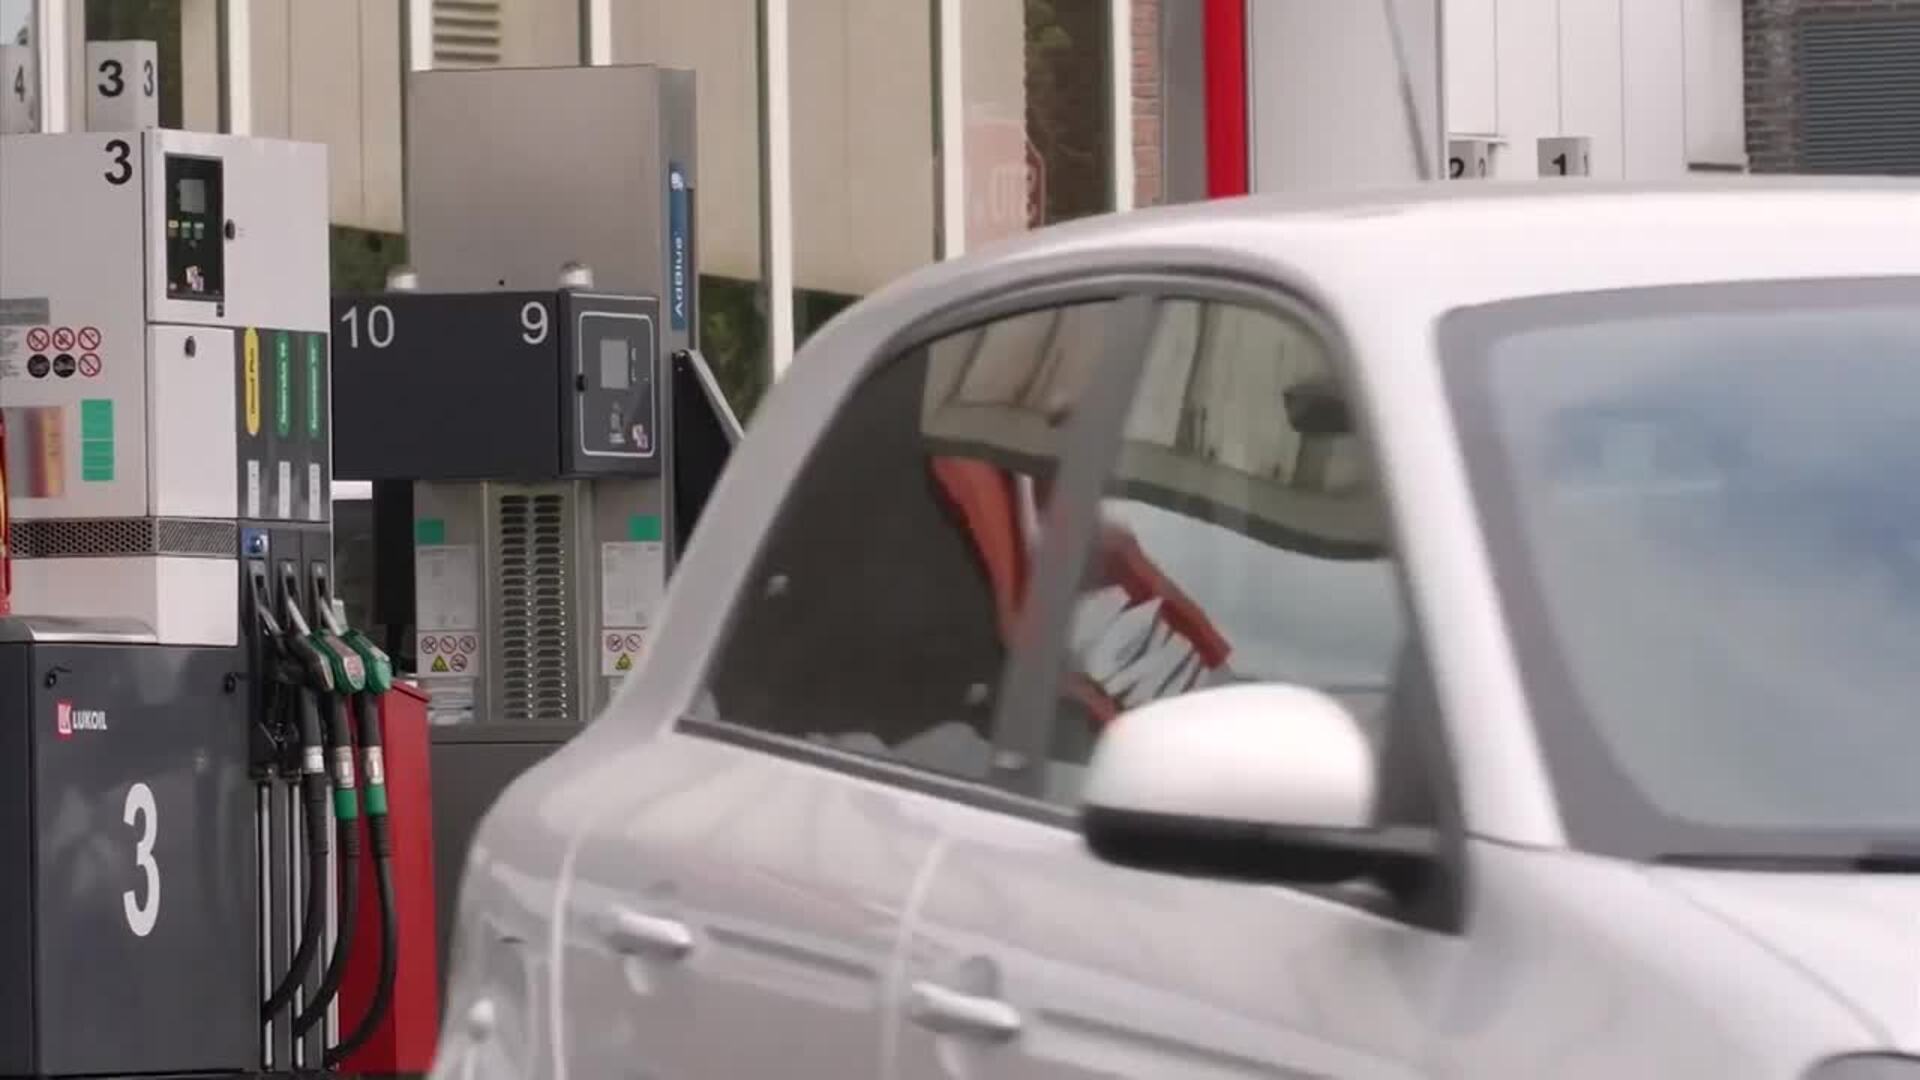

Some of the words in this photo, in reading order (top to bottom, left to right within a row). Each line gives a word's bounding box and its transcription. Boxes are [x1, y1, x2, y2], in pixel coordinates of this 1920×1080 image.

[14, 65, 25, 103] 4
[97, 59, 125, 98] 3
[143, 59, 154, 97] 3
[104, 139, 133, 185] 3
[1552, 153, 1567, 176] 1
[674, 236, 684, 318] AdBlue
[340, 304, 395, 349] 10
[520, 301, 549, 345] 9
[72, 710, 108, 730] LUKOIL
[122, 783, 161, 937] 3
